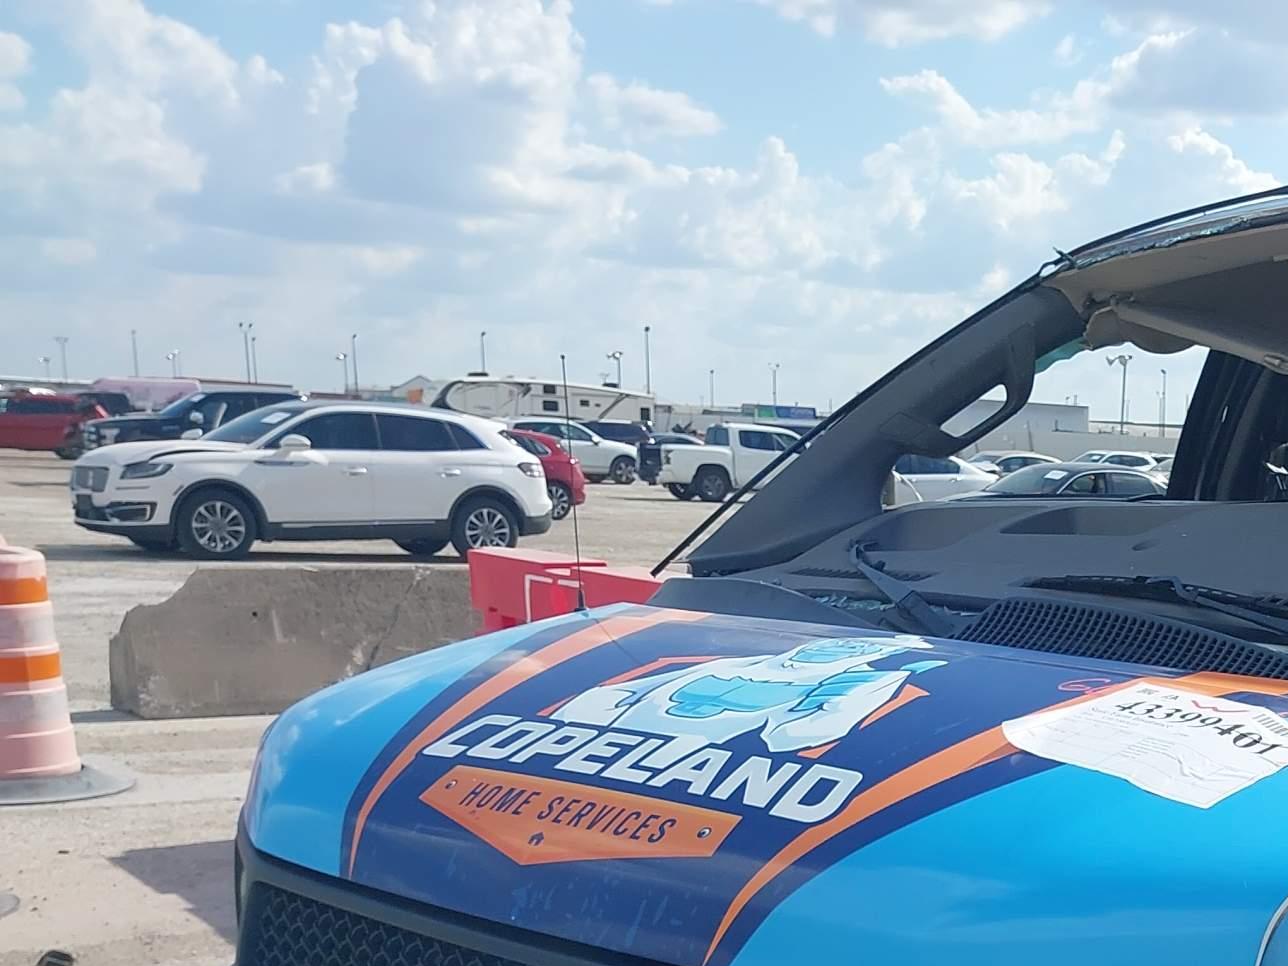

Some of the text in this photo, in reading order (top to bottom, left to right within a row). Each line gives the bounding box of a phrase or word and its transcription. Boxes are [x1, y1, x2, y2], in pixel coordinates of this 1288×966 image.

[1115, 700, 1282, 757] 43399401
[422, 714, 863, 822] COPELAND
[459, 781, 678, 844] HOME SERVICES
